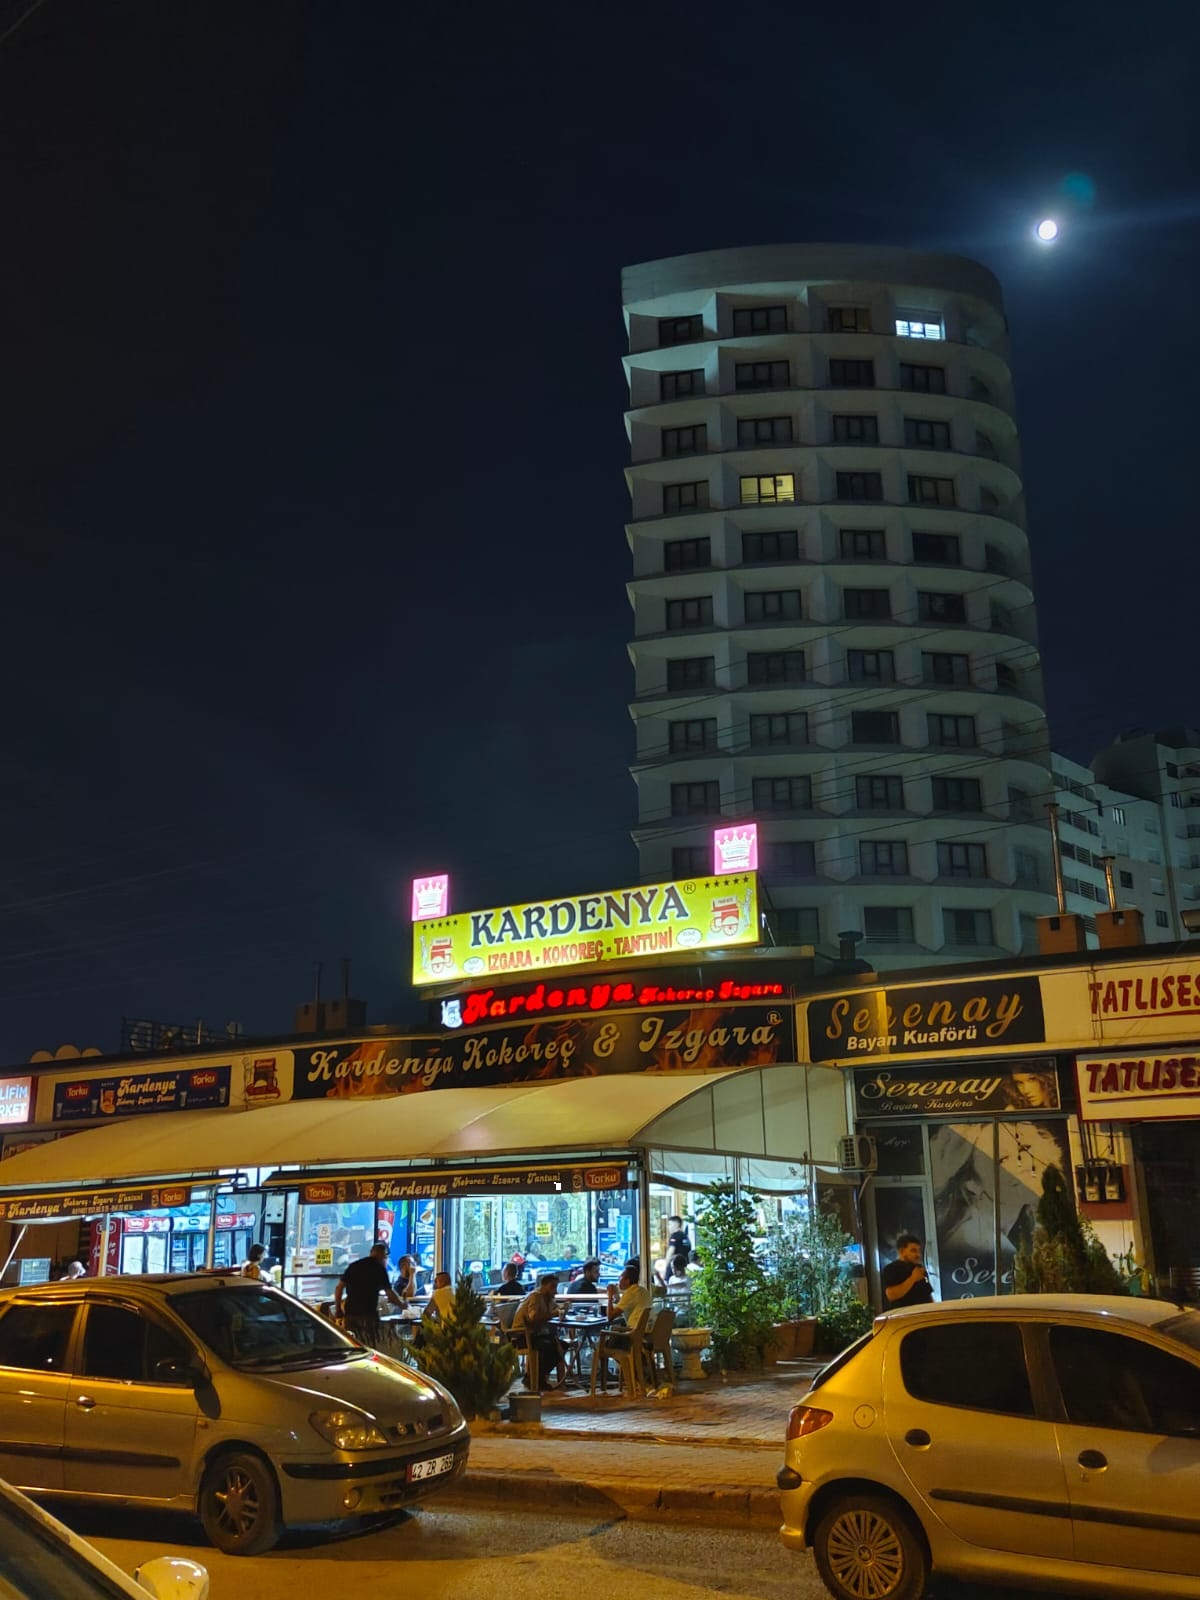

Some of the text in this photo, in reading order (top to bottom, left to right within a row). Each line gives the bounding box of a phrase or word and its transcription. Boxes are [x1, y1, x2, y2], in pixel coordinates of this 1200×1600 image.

[471, 885, 688, 947] KARDENYA
[488, 949, 532, 971] IZGARA
[543, 939, 604, 963] KOKOREÇ
[613, 926, 673, 954] TANTUNİ
[463, 984, 634, 1024] Kardenya
[847, 1025, 977, 1052] Bayan Kuaförü
[307, 1050, 454, 1086] Kardenya
[462, 1036, 576, 1068] Kokoreç
[592, 1022, 620, 1057] &
[638, 1016, 774, 1062] Izgara
[192, 1073, 216, 1085] Torku
[1086, 1057, 1200, 1092] TATLISE
[67, 1086, 89, 1097] Torku
[117, 1078, 177, 1097] Kardenya
[860, 1072, 1002, 1101] Serenay
[378, 1180, 447, 1199] Kardenya
[589, 1172, 617, 1184] Torku
[309, 1187, 331, 1197] Torku
[7, 1203, 60, 1218] Kardenya
